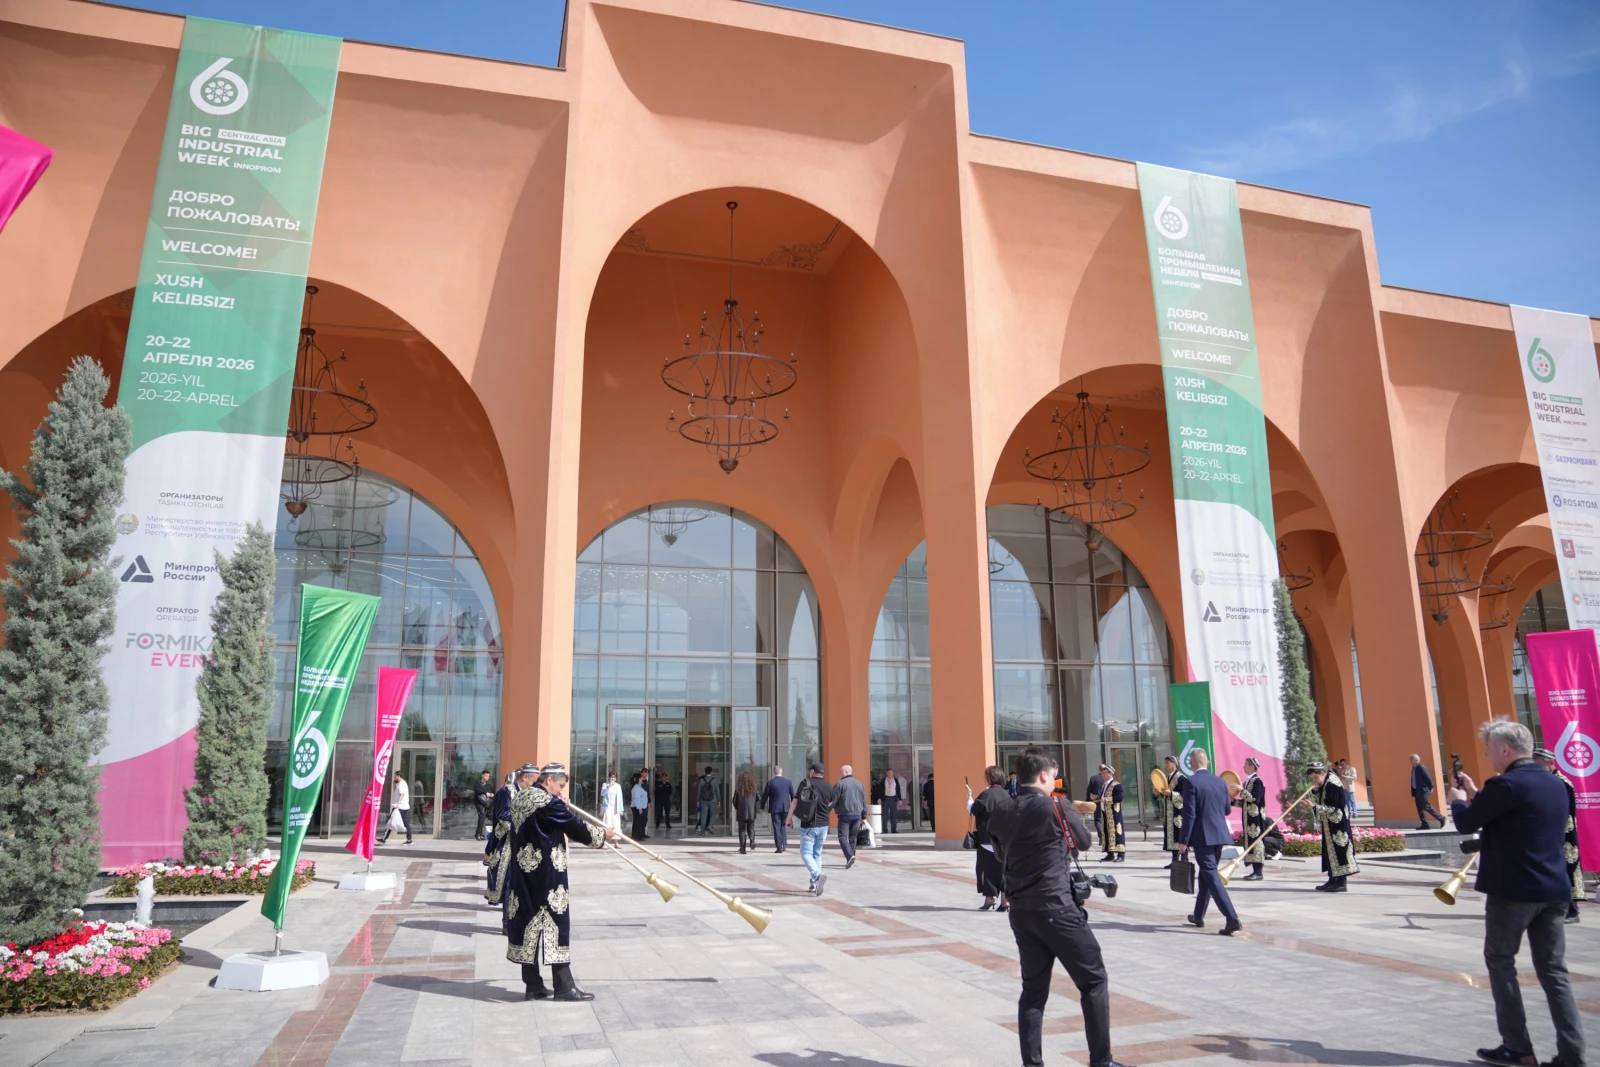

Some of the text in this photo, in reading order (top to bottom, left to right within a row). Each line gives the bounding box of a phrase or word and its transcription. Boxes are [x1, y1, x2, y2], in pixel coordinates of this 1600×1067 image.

[189, 56, 249, 116] 6
[181, 124, 283, 145] BIG CENTRAL ASIA
[178, 137, 283, 160] INDUSTRIAL
[177, 151, 282, 174] WEEK INNOPROM
[168, 189, 235, 206] ДОБРО
[166, 206, 301, 231] ПОЖАЛОВАТЬ!
[1154, 196, 1188, 240] 6
[161, 239, 258, 259] WELCOME!
[1158, 247, 1206, 261] БОЛЬШАЯ
[1159, 256, 1241, 276] ПРОМЫШЛЕННАЯ
[1160, 266, 1200, 278] НЕДЕЛЯ
[154, 274, 204, 288] XUSH
[152, 291, 235, 309] KELIBSIZ!
[1166, 308, 1208, 321] ДОБРО
[1168, 321, 1249, 342] ПОЖАЛОВАТЬ!
[142, 352, 255, 371] АПРЕЛЯ 2026
[1172, 348, 1232, 365] WELCOME!
[1527, 338, 1556, 383] 6
[139, 372, 205, 388] 2026-YIL
[1175, 376, 1206, 389] XUSH
[1176, 390, 1228, 405] KELIBSIZ!
[1532, 391, 1547, 400] BIG
[1534, 401, 1585, 416] INDUSTRIAL
[1537, 412, 1561, 424] WEEK
[1181, 440, 1247, 455] АПРЕЛЯ 2026
[1182, 456, 1222, 469] 2026-YIL
[157, 499, 224, 509] TASHKILOTCHILAR
[160, 492, 223, 502] ОРГАНИЗАТОРЫ
[1562, 498, 1598, 509] ROSATOM
[146, 516, 203, 525] Министерство
[144, 529, 194, 539] Республики
[164, 562, 218, 573] Минпром
[163, 571, 206, 581] России
[156, 607, 200, 615] ОПЕРАТОР
[1225, 606, 1269, 614] Минпромторг
[156, 614, 198, 622] OPERATOR
[1214, 660, 1268, 674] FORMIKA
[1230, 675, 1268, 686] EVENT
